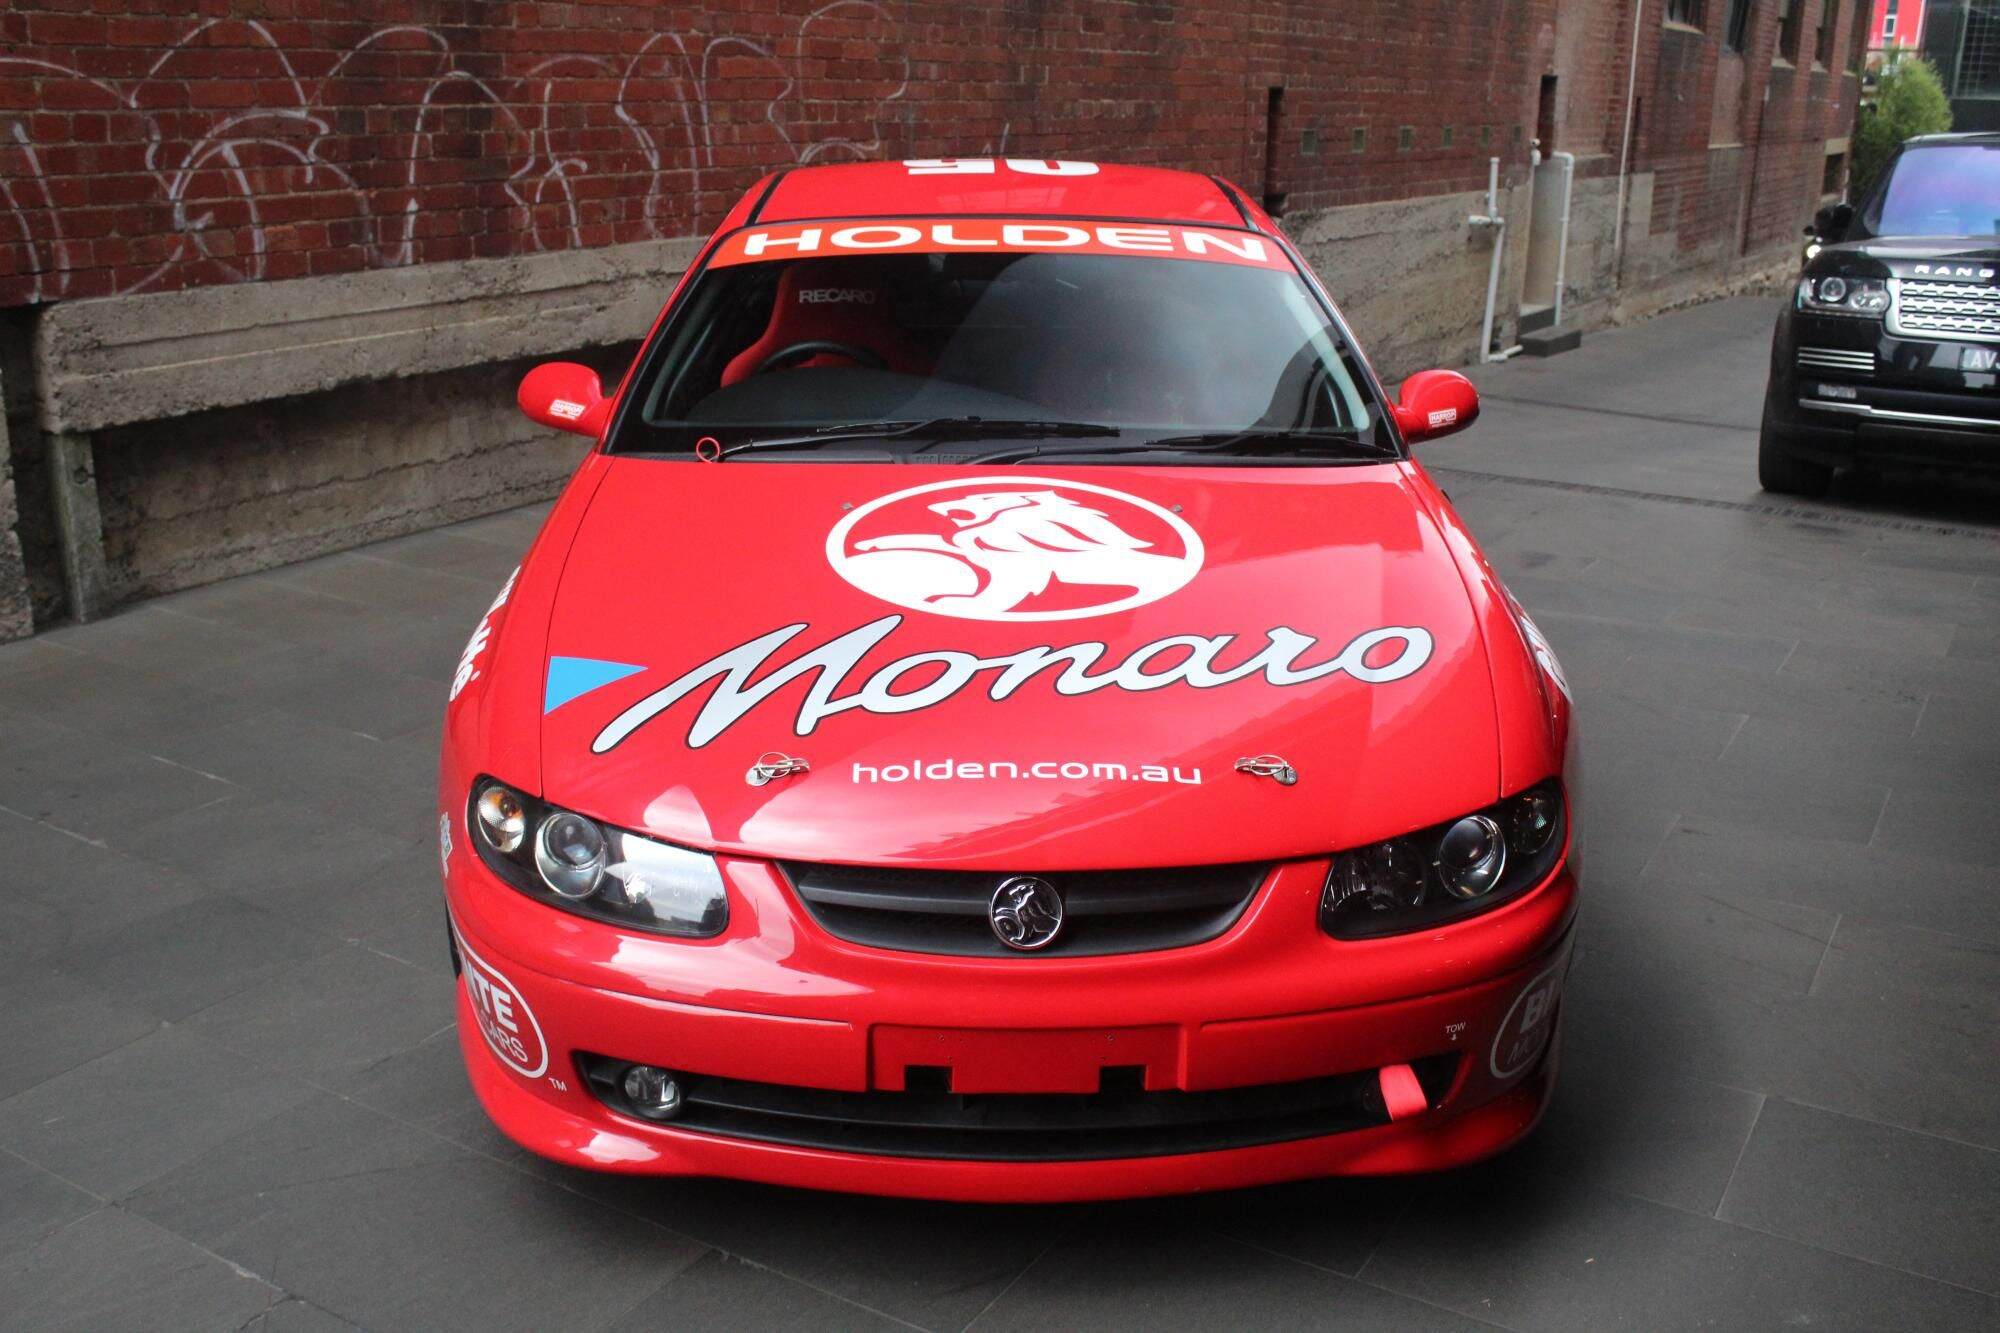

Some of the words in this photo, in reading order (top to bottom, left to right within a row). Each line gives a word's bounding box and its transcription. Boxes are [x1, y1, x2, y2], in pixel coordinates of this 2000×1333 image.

[744, 225, 1267, 263] HOLDEN
[798, 287, 875, 304] RECARO
[1969, 350, 2000, 370] AV
[590, 613, 1436, 756] Monaro
[851, 759, 1203, 785] holden.com.au
[1445, 1021, 1466, 1034] TOW
[548, 1077, 568, 1092] TM
